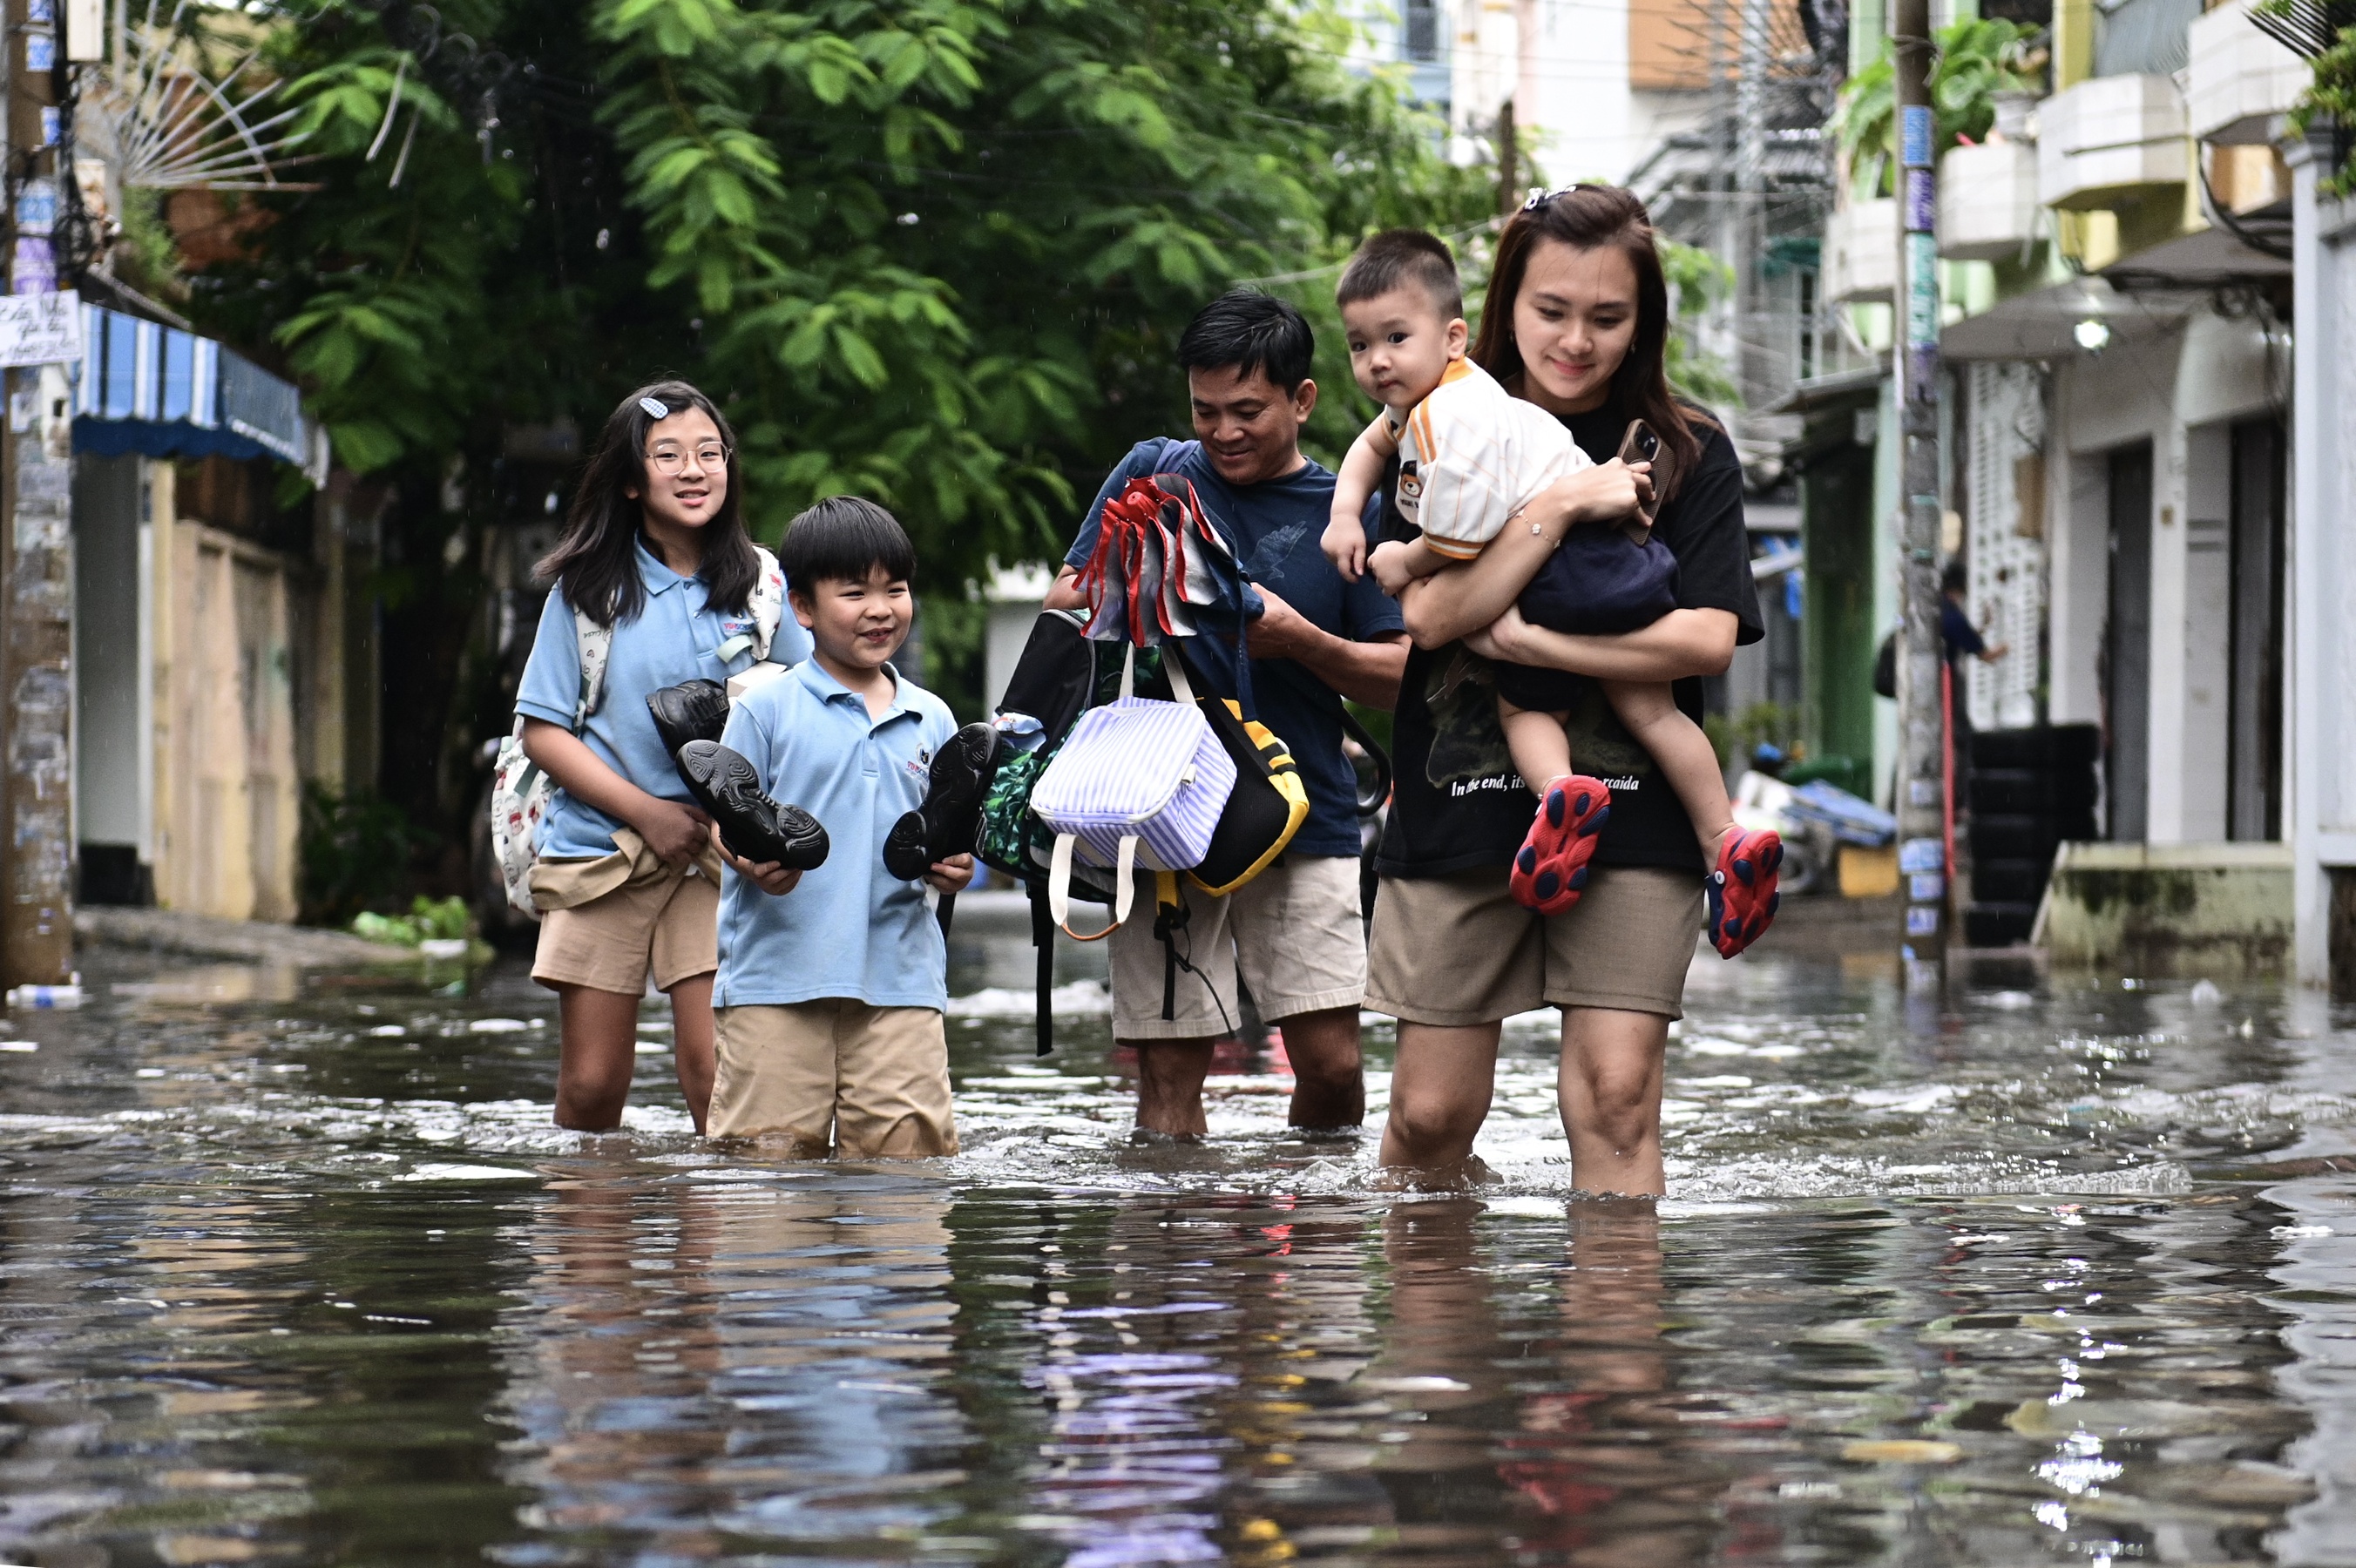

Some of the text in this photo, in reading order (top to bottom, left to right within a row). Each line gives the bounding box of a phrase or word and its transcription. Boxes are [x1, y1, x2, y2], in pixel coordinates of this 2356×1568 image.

[1452, 781, 1465, 796] In
[1481, 774, 1507, 792] end,
[1601, 775, 1640, 790] rcaida
